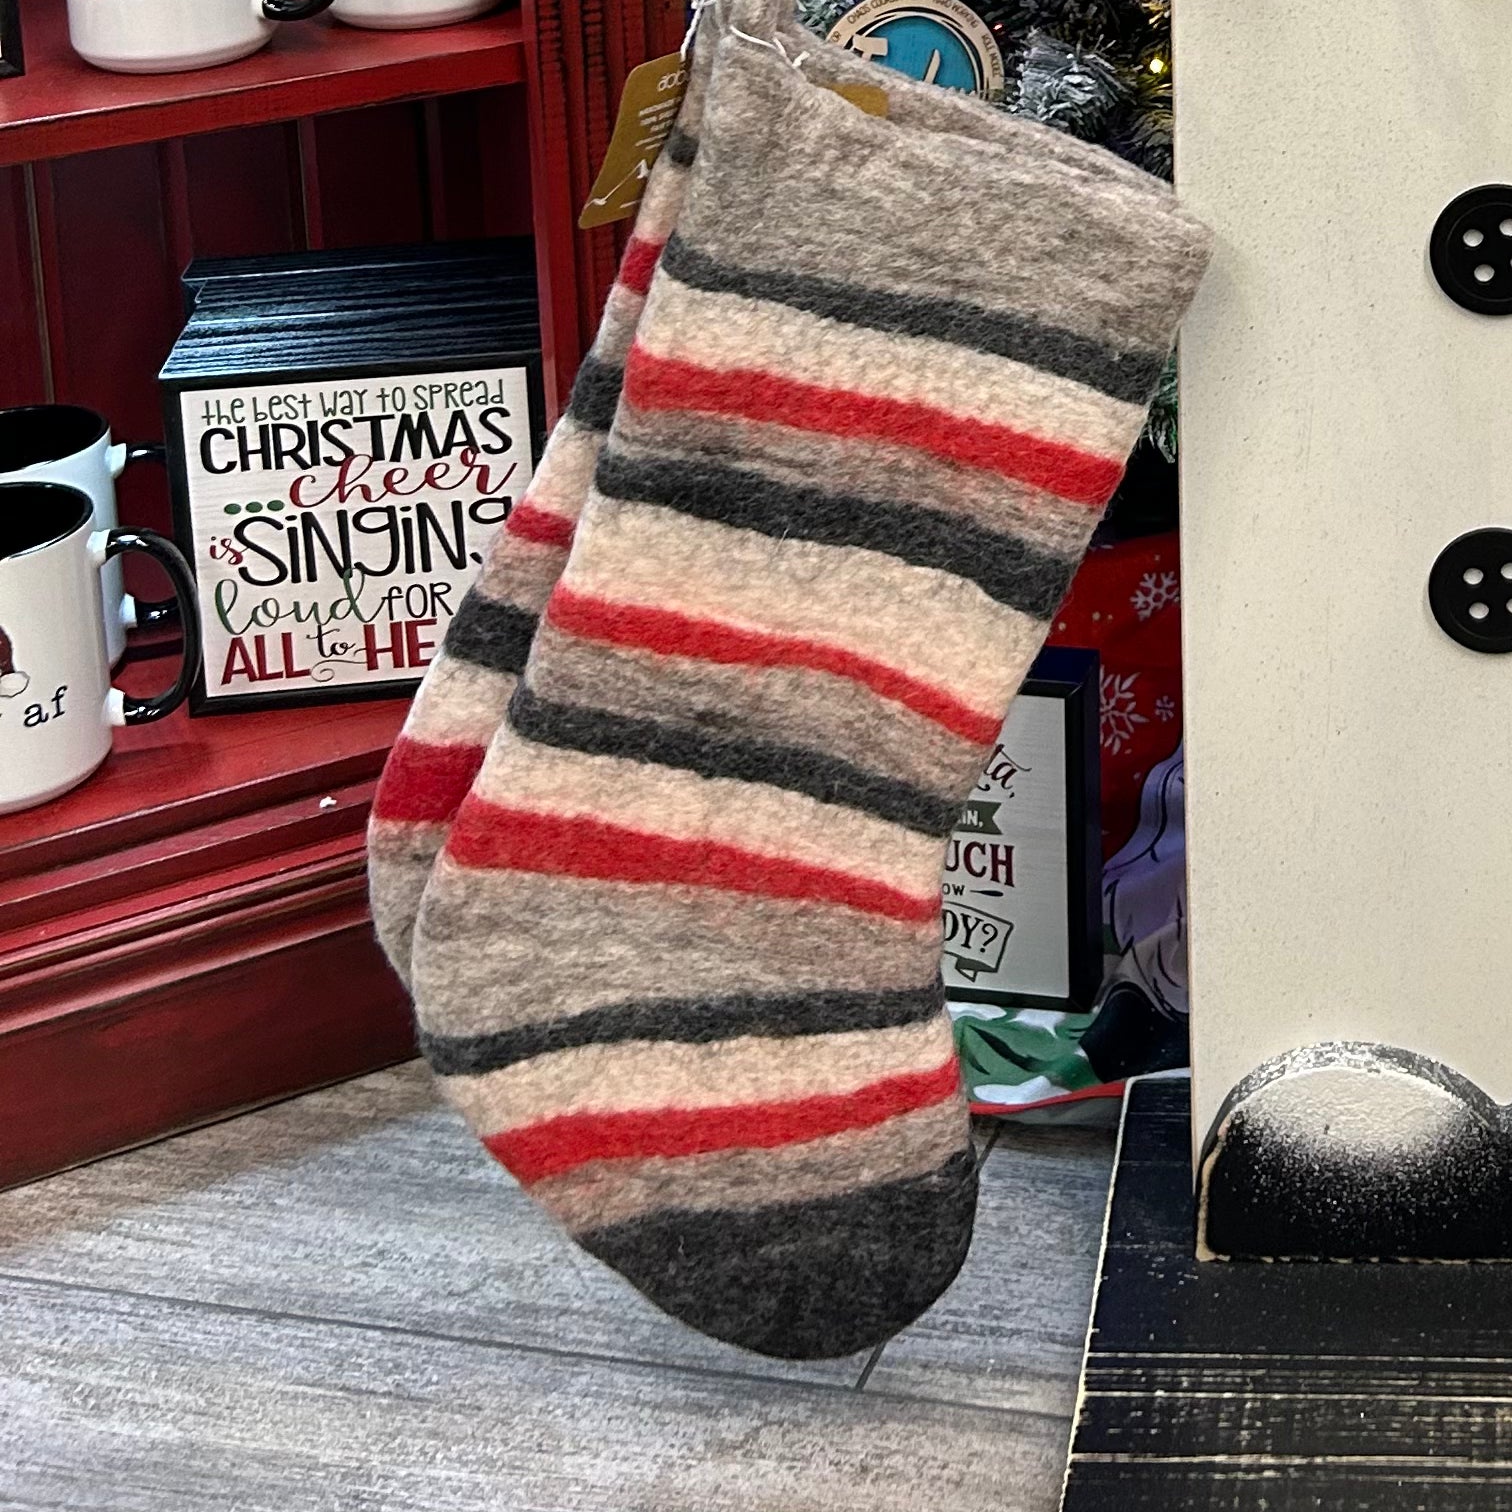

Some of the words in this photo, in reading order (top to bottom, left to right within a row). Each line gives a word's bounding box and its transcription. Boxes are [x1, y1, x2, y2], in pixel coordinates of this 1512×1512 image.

[846, 5, 871, 24] CHAOS
[201, 398, 245, 426] the
[253, 393, 313, 424] best
[377, 387, 406, 414] to
[199, 406, 513, 474] CHRISTMAS
[289, 447, 518, 508] cheer
[209, 536, 244, 567] is
[214, 568, 390, 635] loud
[221, 631, 311, 686] ALL
[306, 625, 356, 659] to
[364, 618, 438, 671] HE
[23, 686, 68, 728] af
[945, 840, 1015, 888] UCH
